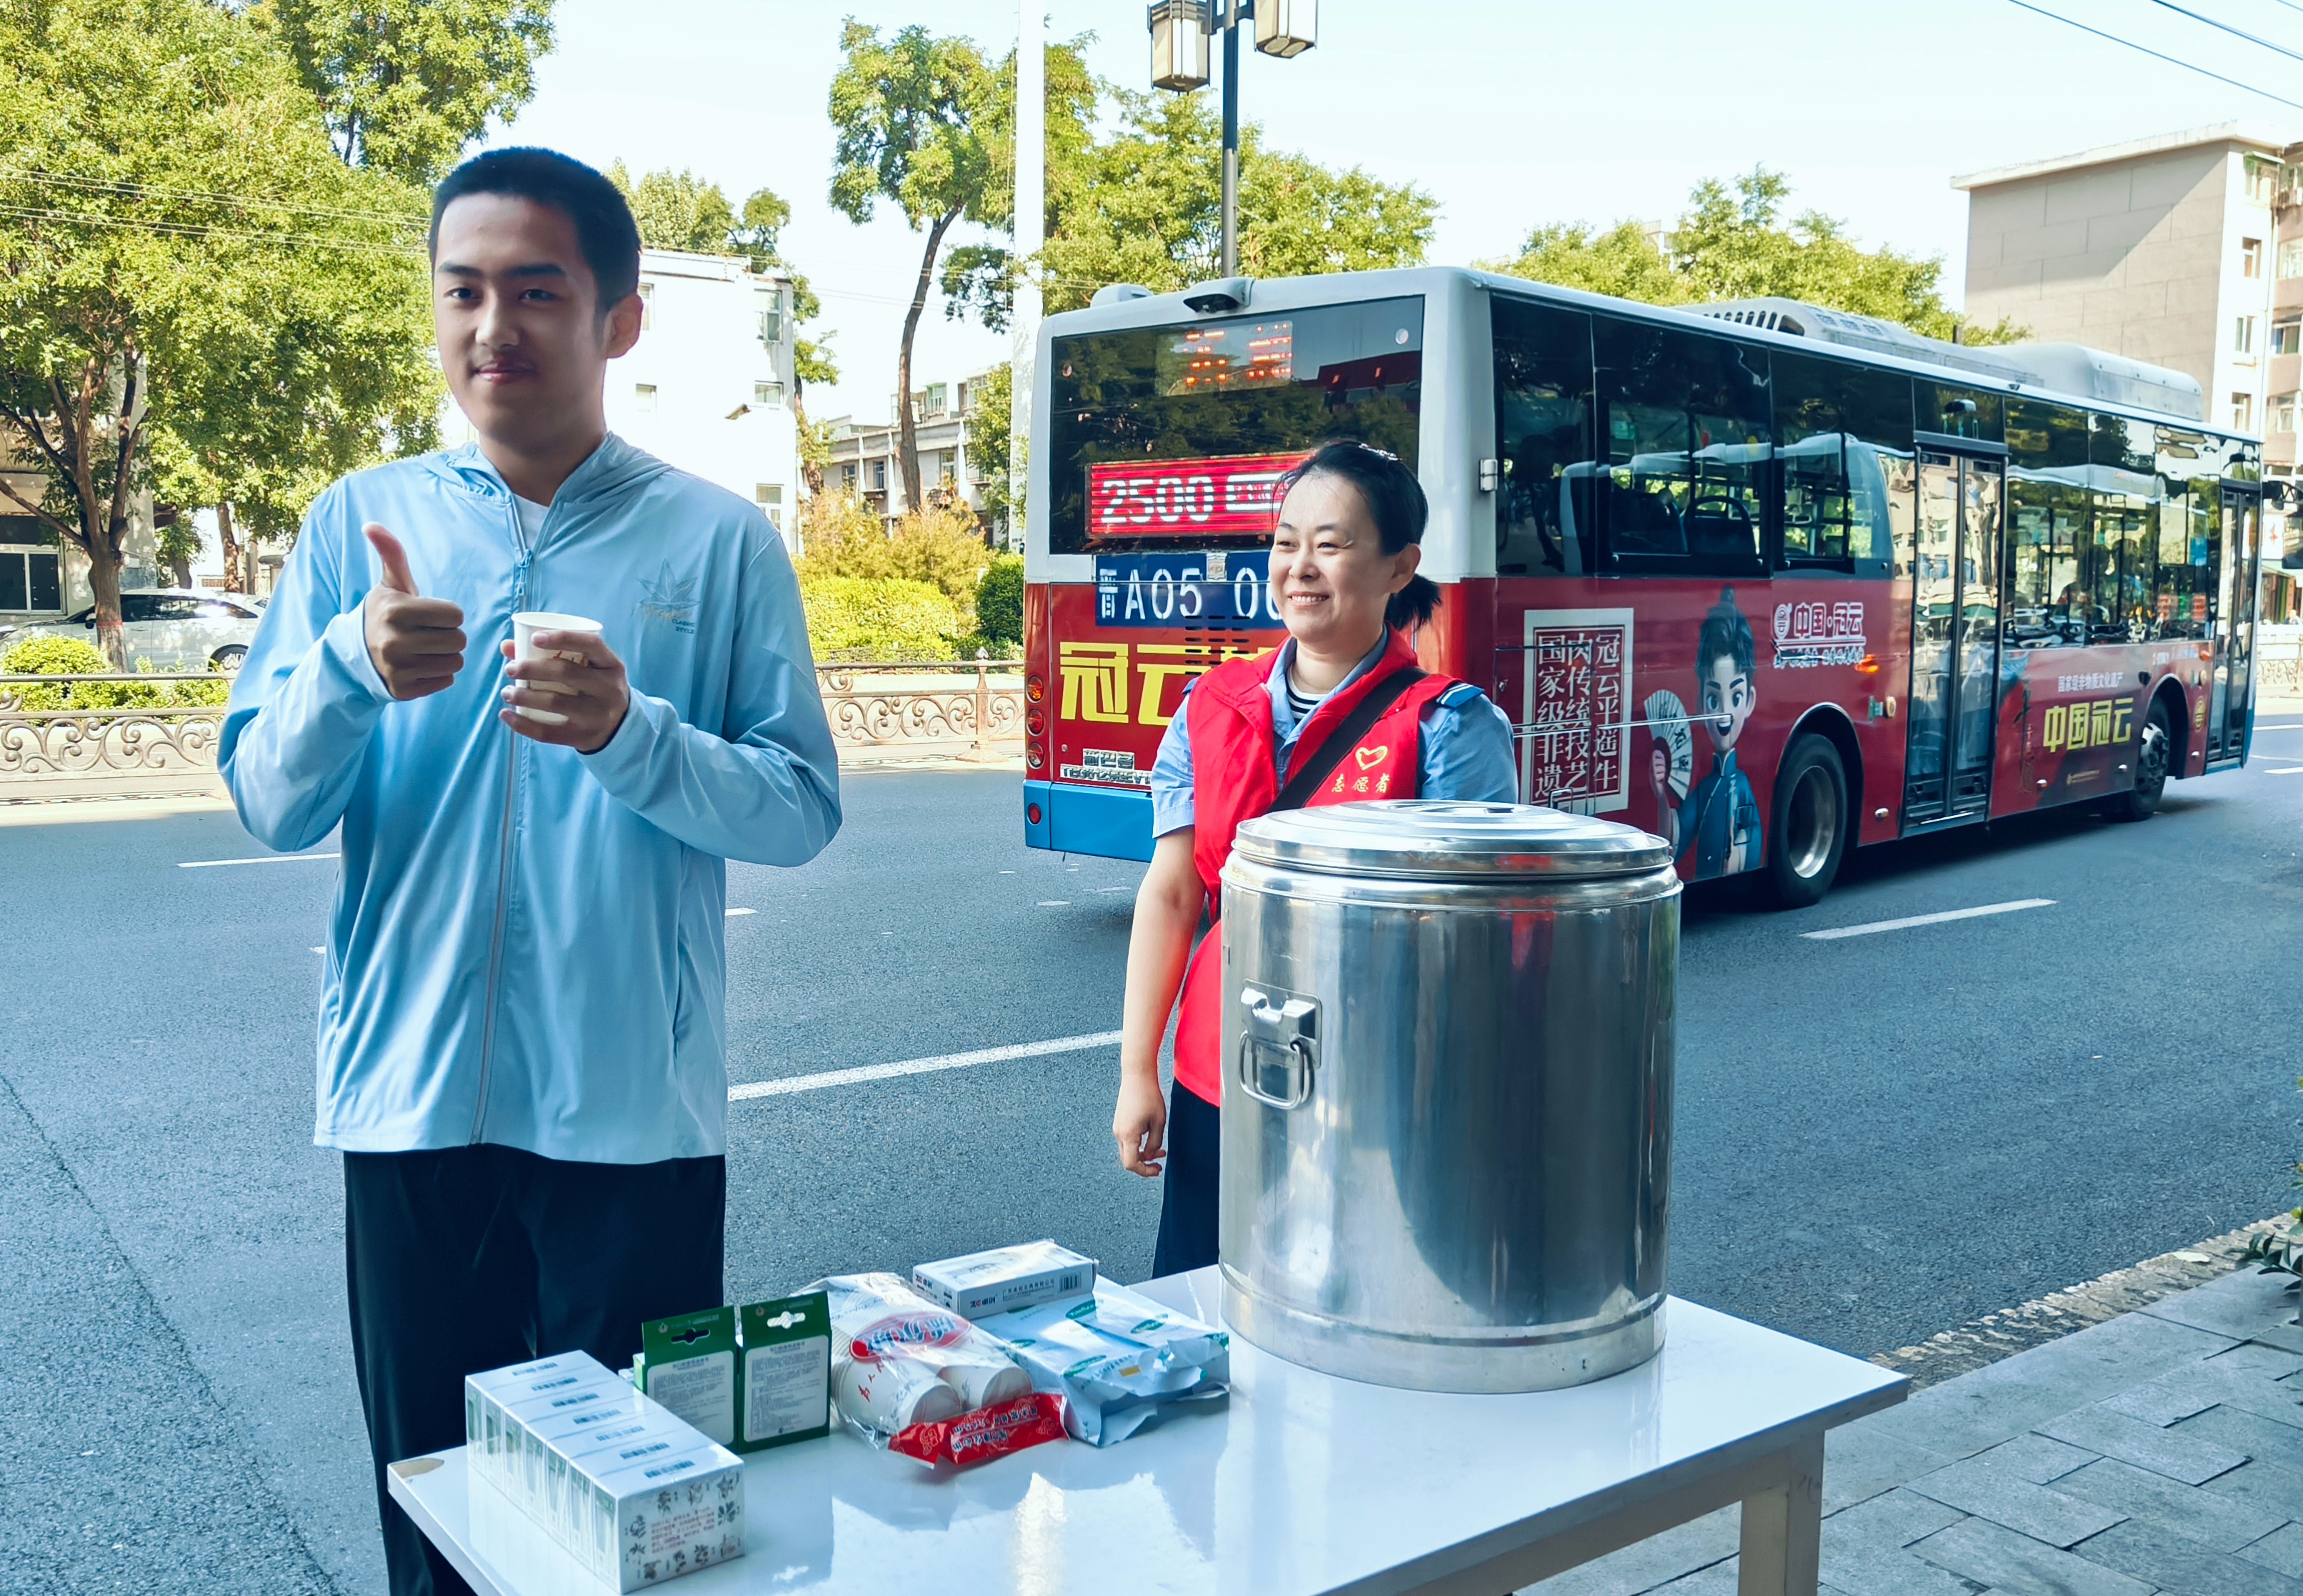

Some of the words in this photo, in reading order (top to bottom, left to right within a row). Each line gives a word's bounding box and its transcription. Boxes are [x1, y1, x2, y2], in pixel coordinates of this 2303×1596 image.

[1100, 477, 1214, 523] 2500
[1059, 641, 1277, 727] 冠云
[1594, 633, 1621, 789] 冠云平遥牛
[2043, 697, 2134, 753] 中国冠云
[1331, 772, 1390, 793] 志愿者
